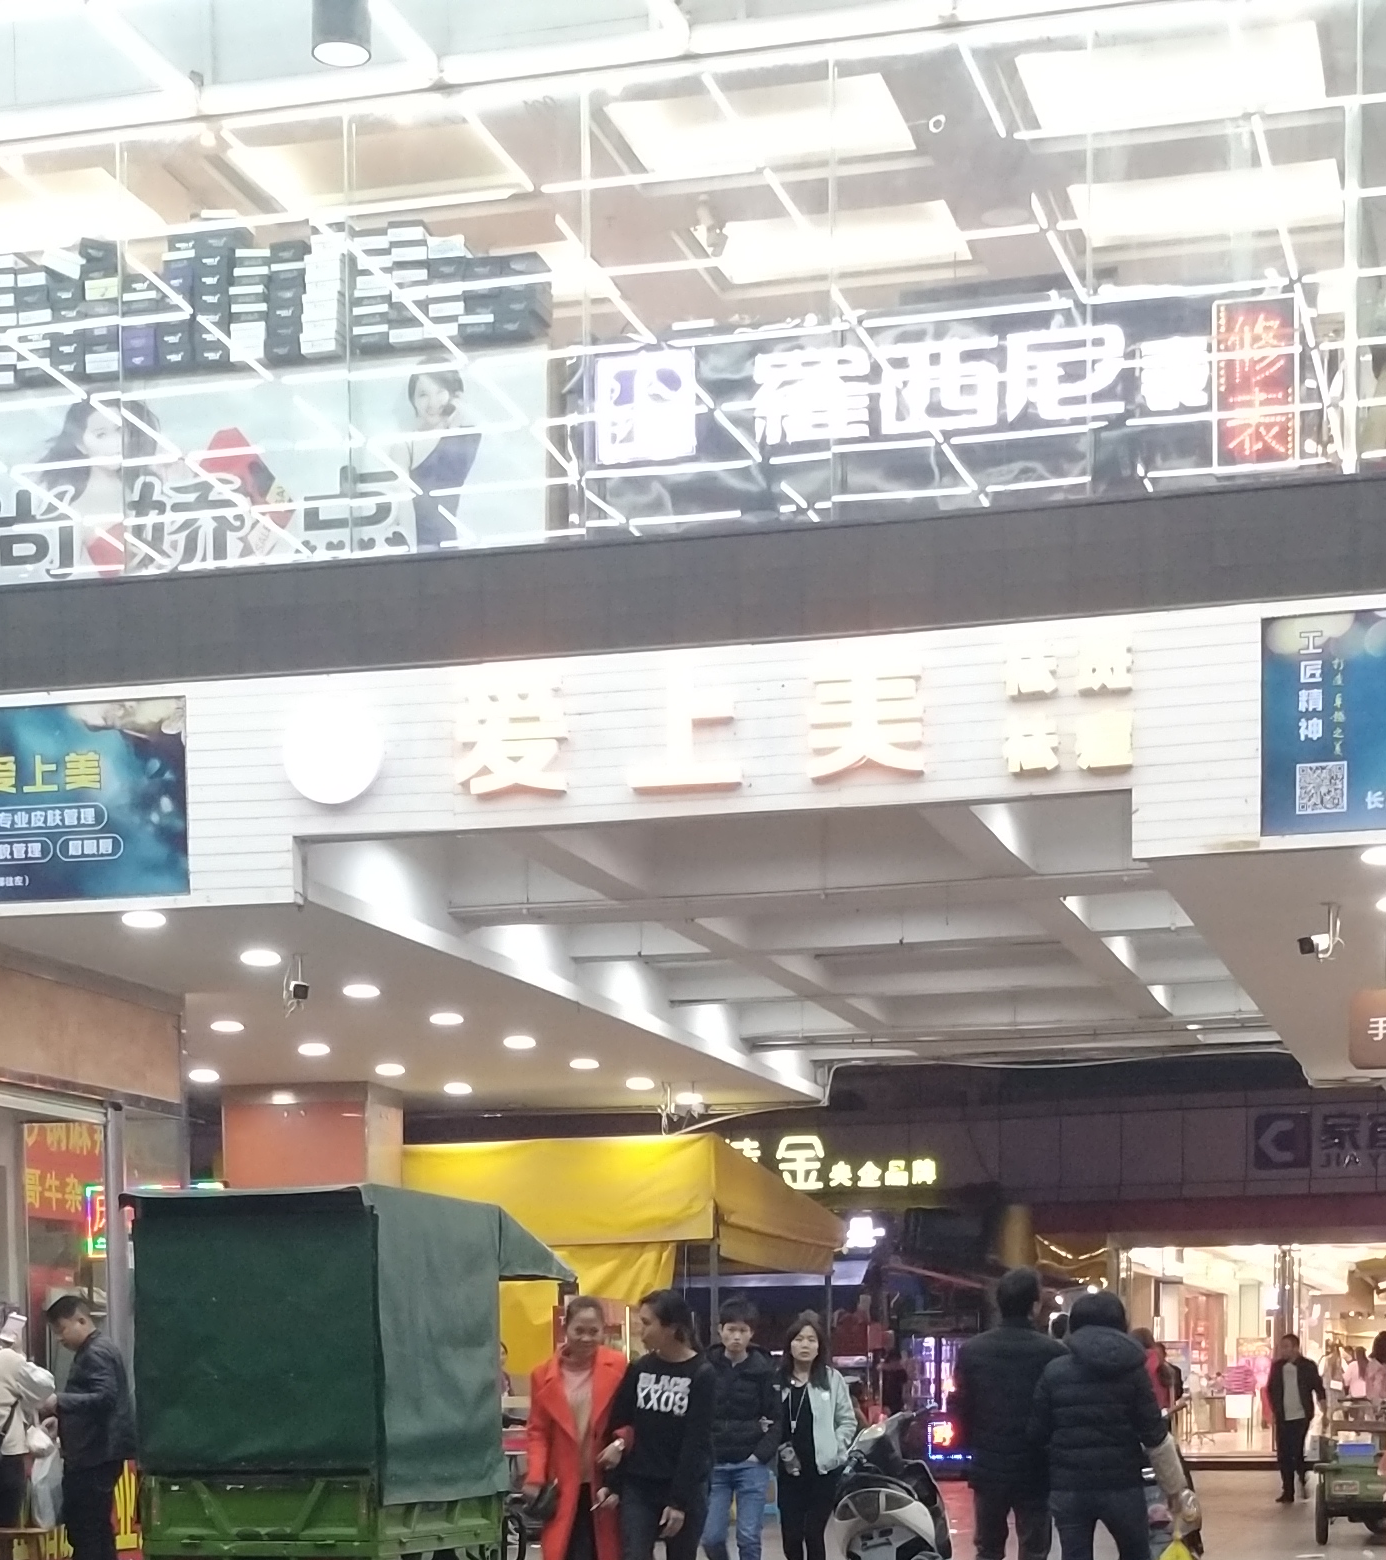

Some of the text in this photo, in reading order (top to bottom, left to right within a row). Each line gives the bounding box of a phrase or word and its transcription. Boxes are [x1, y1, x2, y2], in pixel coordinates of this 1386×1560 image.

[454, 660, 926, 796] 爱上美
[1299, 630, 1323, 742] 工匠精神
